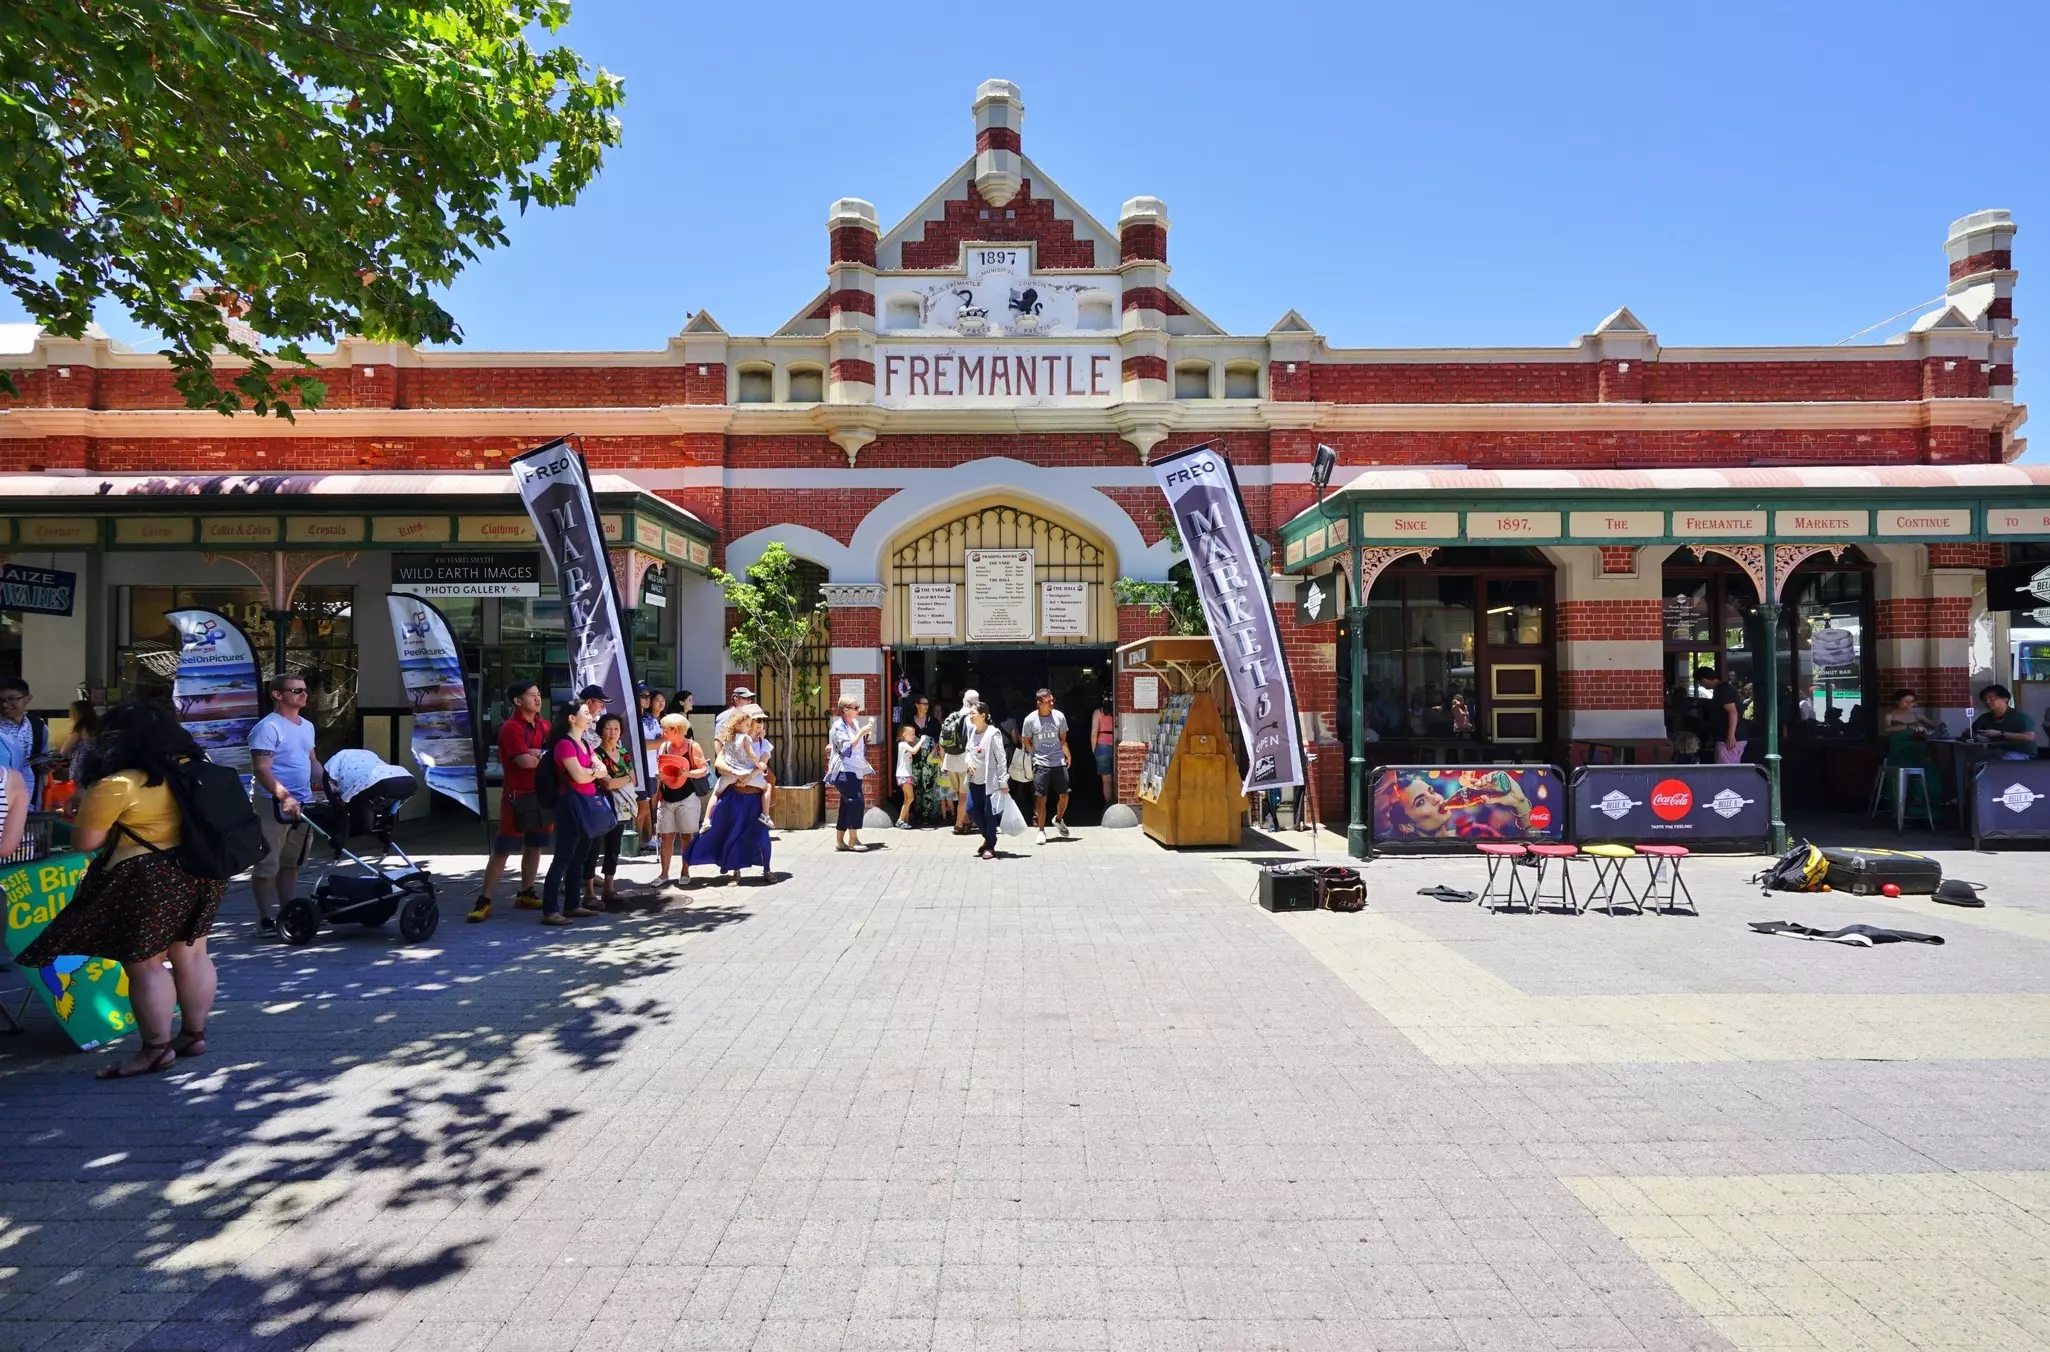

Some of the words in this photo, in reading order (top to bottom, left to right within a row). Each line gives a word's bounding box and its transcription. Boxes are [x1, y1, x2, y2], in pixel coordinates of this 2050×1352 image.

[980, 251, 1016, 266] 1897
[981, 268, 1015, 276] MUNICIPAL
[947, 279, 982, 291] FREMANTLE
[1018, 279, 1049, 289] COUNCIL
[885, 355, 1111, 396] FREMANTLE
[525, 457, 569, 484] FREO
[1166, 461, 1216, 487] FREO
[1497, 518, 1532, 531] 1897,
[1685, 518, 1753, 530] FREMANTLE
[1794, 518, 1849, 529] MARKETS
[1896, 517, 1950, 528] CONTINUE
[2004, 517, 2019, 527] TO
[2043, 517, 2050, 526] B
[307, 523, 346, 536] Crystals
[481, 523, 519, 535] Clothing
[0, 567, 56, 585] AIZE
[400, 568, 433, 579] WILD
[438, 568, 479, 579] EARTH
[484, 566, 532, 578] IMAGES
[425, 586, 460, 594] PHOTO
[463, 585, 507, 594] GALLERY
[2037, 580, 2050, 591] BEL
[0, 581, 70, 611] WARES
[551, 500, 607, 688] MARKET
[1184, 502, 1272, 719] MARKETS
[2038, 608, 2050, 617] BELL
[180, 653, 245, 665] eelOnPictures
[1256, 734, 1280, 754] OPEN
[1606, 800, 1621, 809] BELLE
[1652, 793, 1691, 806] Coca-Cola
[1718, 799, 1733, 808] BELLE
[2008, 795, 2022, 803] BELLE
[1, 868, 29, 890] SSIE
